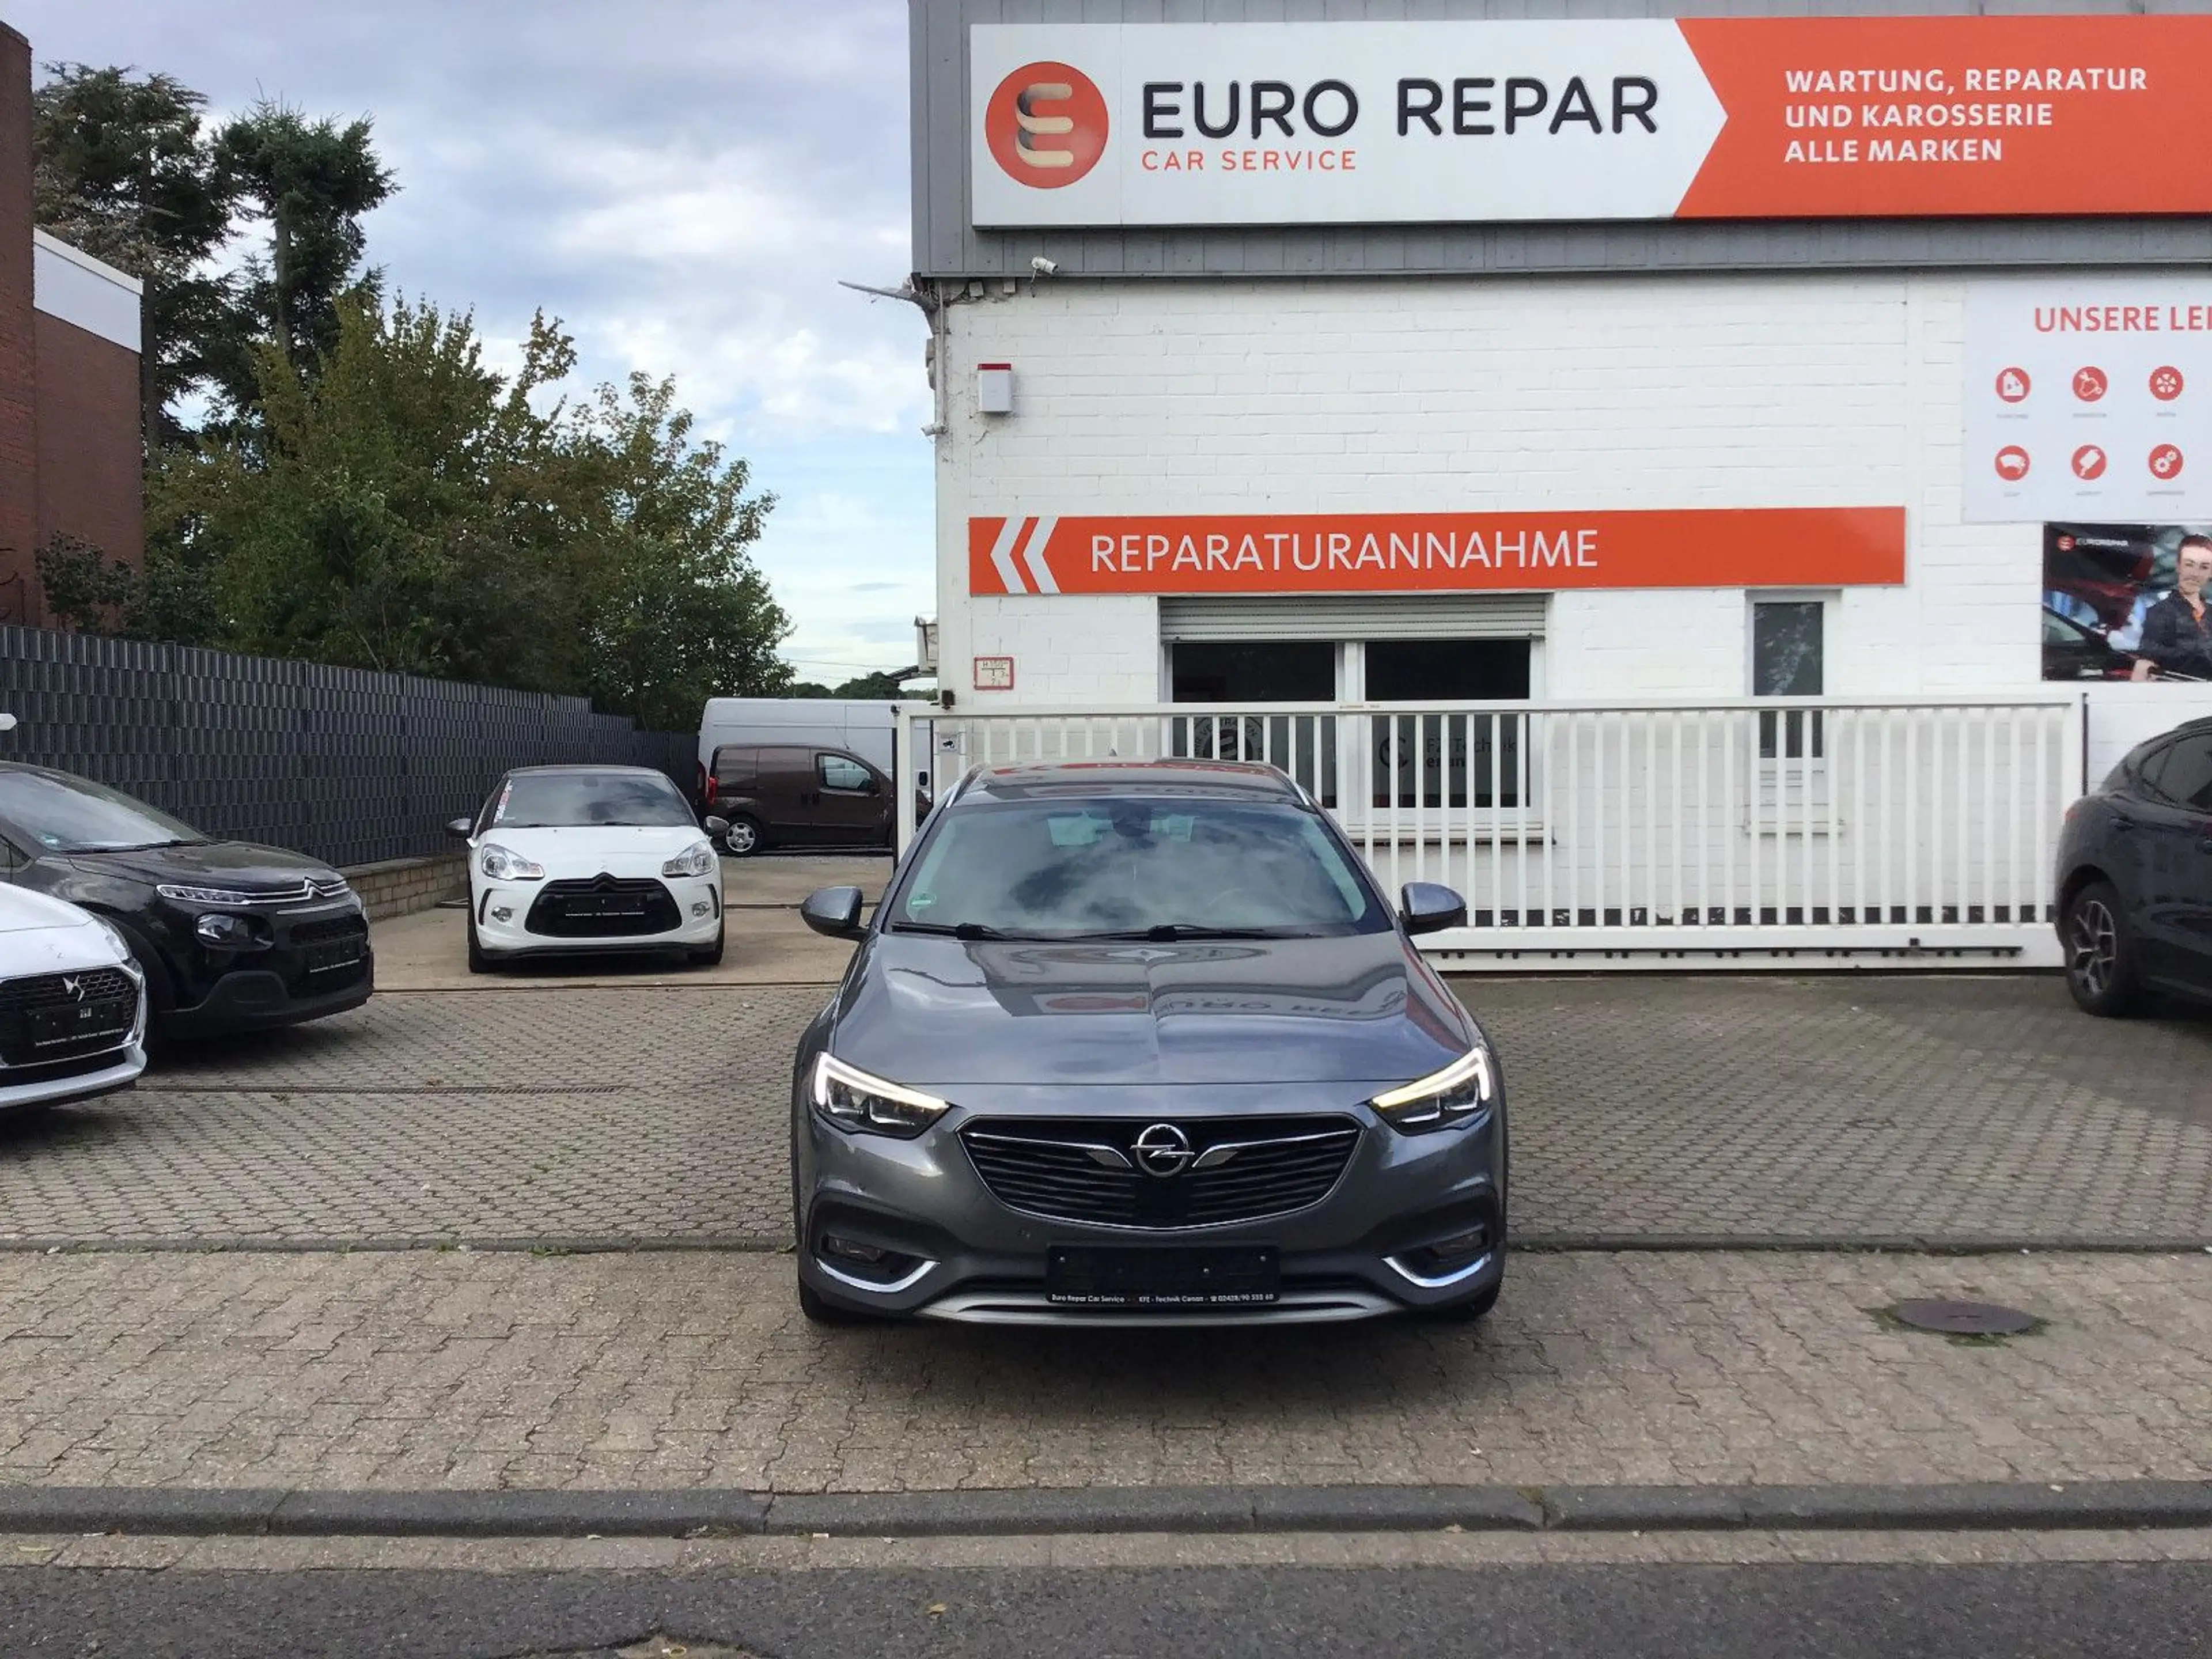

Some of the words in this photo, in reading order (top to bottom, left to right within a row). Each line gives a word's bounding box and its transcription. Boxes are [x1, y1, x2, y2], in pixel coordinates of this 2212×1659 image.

[1786, 69, 1954, 94] WARTUNG,
[1965, 67, 2147, 91] REPARATUR
[1142, 79, 1359, 140] EURO
[1397, 75, 1658, 137] REPAR
[1786, 104, 1852, 128] UND
[1862, 103, 2053, 127] KAROSSERIE
[1141, 150, 1204, 171] CAR
[1222, 150, 1357, 171] SERVICE
[1785, 140, 1858, 162] ALLE
[1868, 139, 2002, 161] MARKEN
[2035, 306, 2160, 332] UNSERE
[1090, 529, 1598, 572] REPARATURANNAHME
[1051, 1293, 1067, 1301] Euro
